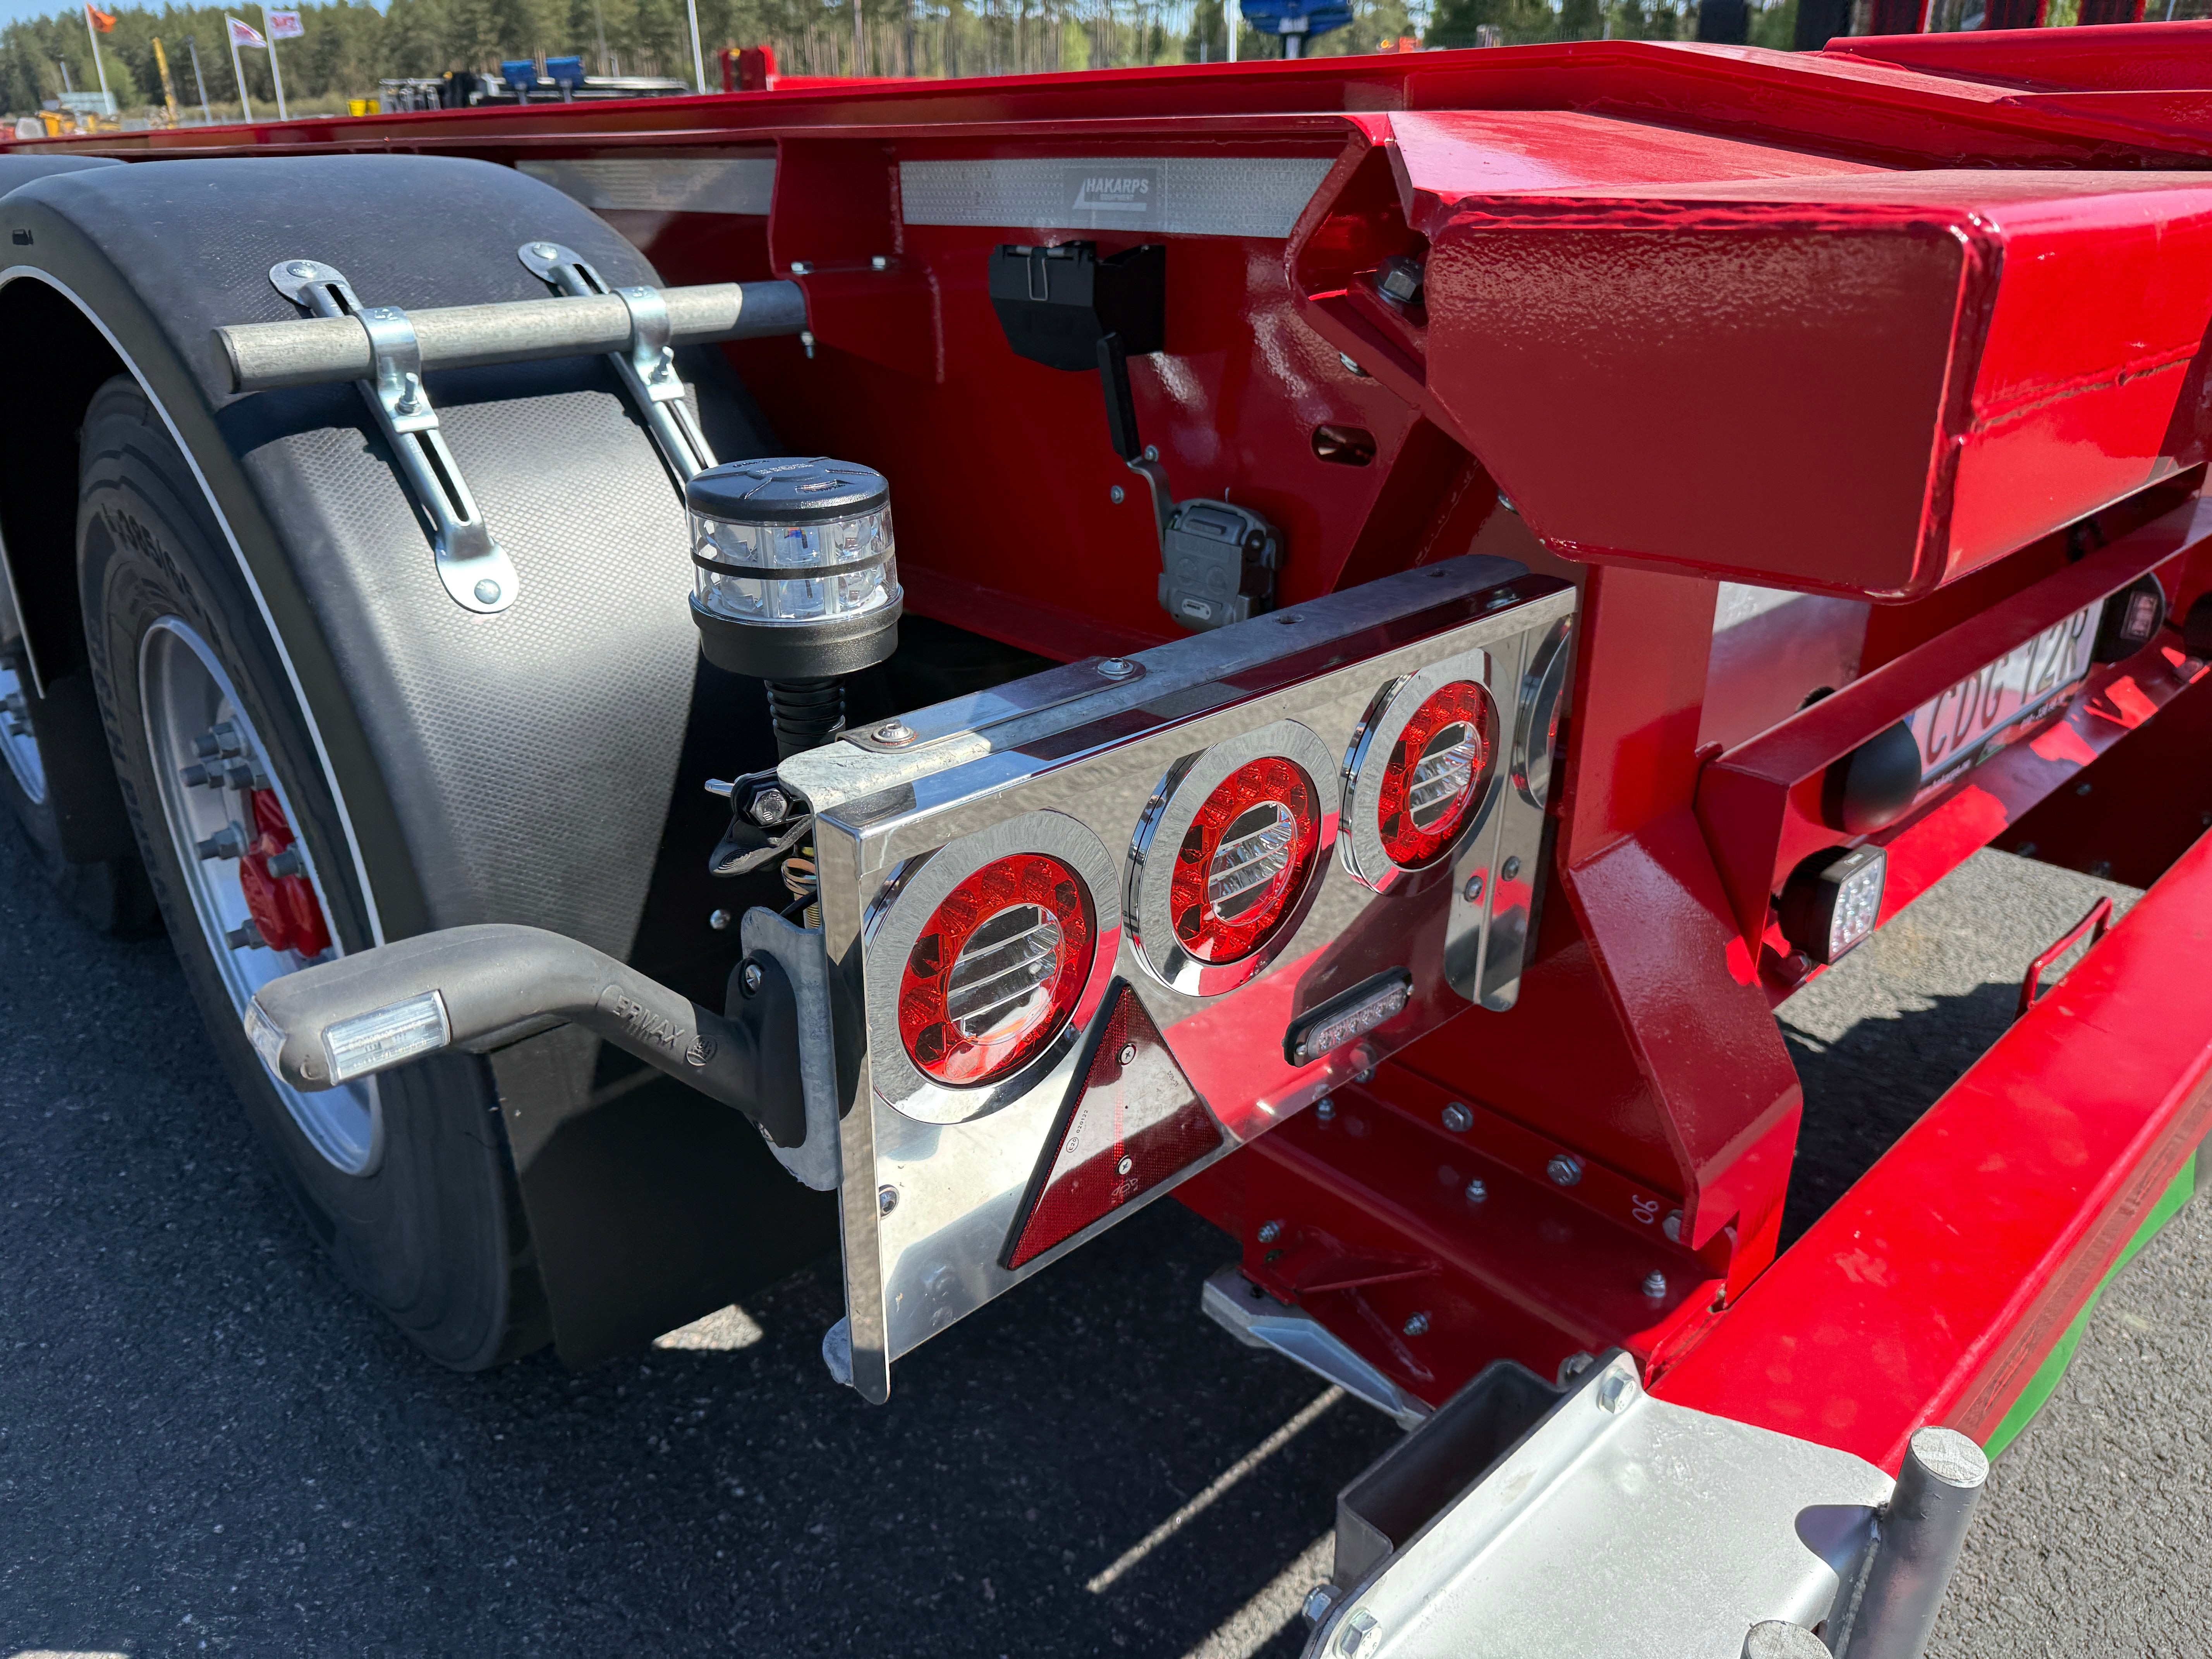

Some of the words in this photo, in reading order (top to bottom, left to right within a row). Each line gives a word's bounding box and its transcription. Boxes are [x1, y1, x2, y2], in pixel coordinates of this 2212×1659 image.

[1086, 178, 1149, 194] HAKARPS
[1926, 654, 2010, 765] CDG
[2020, 606, 2089, 705] 12R
[1076, 1109, 1089, 1133] 020122
